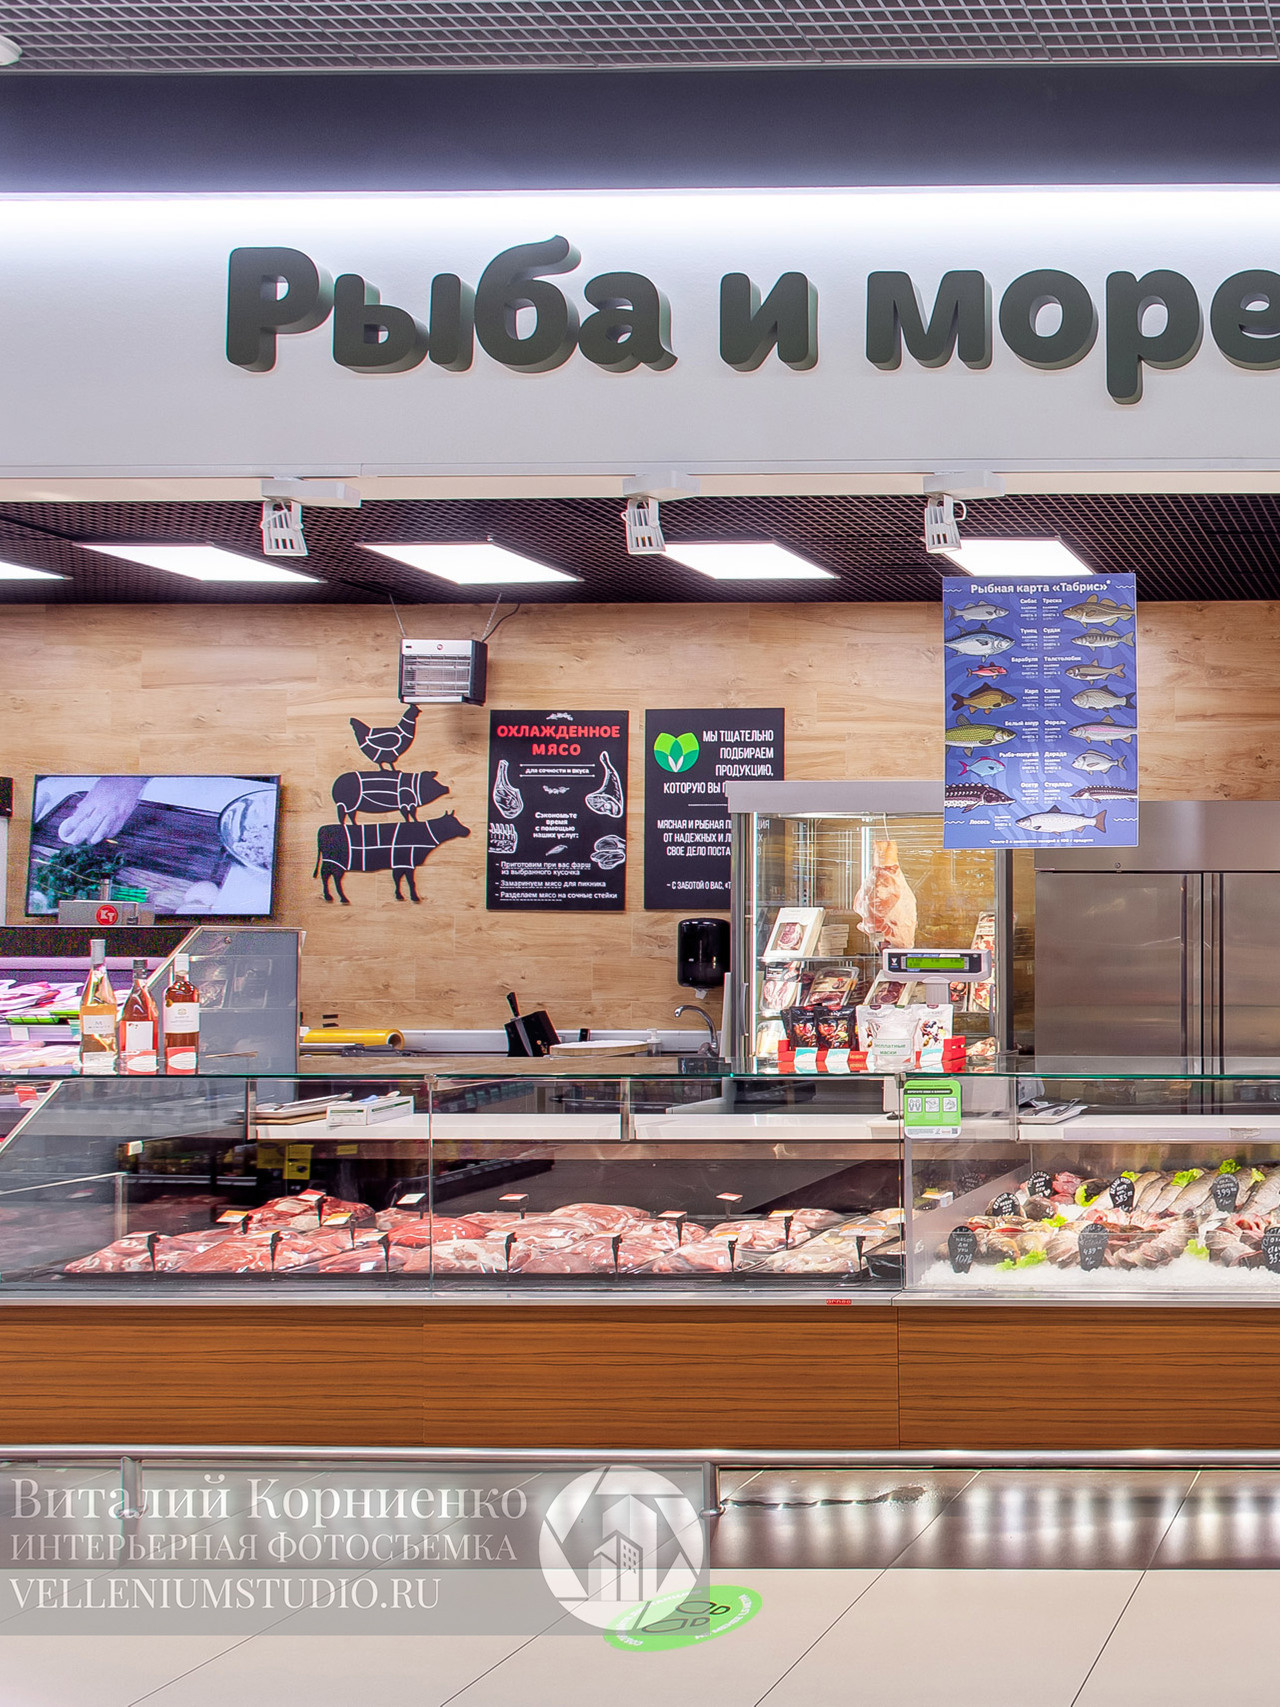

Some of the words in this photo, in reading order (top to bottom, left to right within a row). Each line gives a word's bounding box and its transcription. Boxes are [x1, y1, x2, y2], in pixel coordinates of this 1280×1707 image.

[226, 233, 678, 376] Рыба
[719, 271, 819, 372] и
[971, 583, 1014, 594] Рыбная
[1017, 583, 1050, 594] карта
[496, 725, 620, 740] ОХЛАЖДЕННОЕ
[702, 730, 718, 742] МЫ
[720, 730, 774, 742] ТЩАТЕЛЬНО
[532, 744, 581, 755] МЯСО
[720, 747, 774, 759] ПОДБИРАЕМ
[716, 764, 774, 777] ПРОДУКЦИЮ,
[663, 782, 706, 794] КОТОРУЮ
[707, 782, 720, 794] ВЫ
[657, 820, 687, 829] МЯСНАЯ
[694, 820, 724, 829] РЫБНАЯ
[674, 833, 717, 843] НАДЕЖНЫХ
[666, 846, 685, 856] СВОЕ
[686, 846, 706, 857] ДЕЛО
[500, 861, 542, 869] Приготовим
[677, 879, 704, 889] ЗАБОТОЙ
